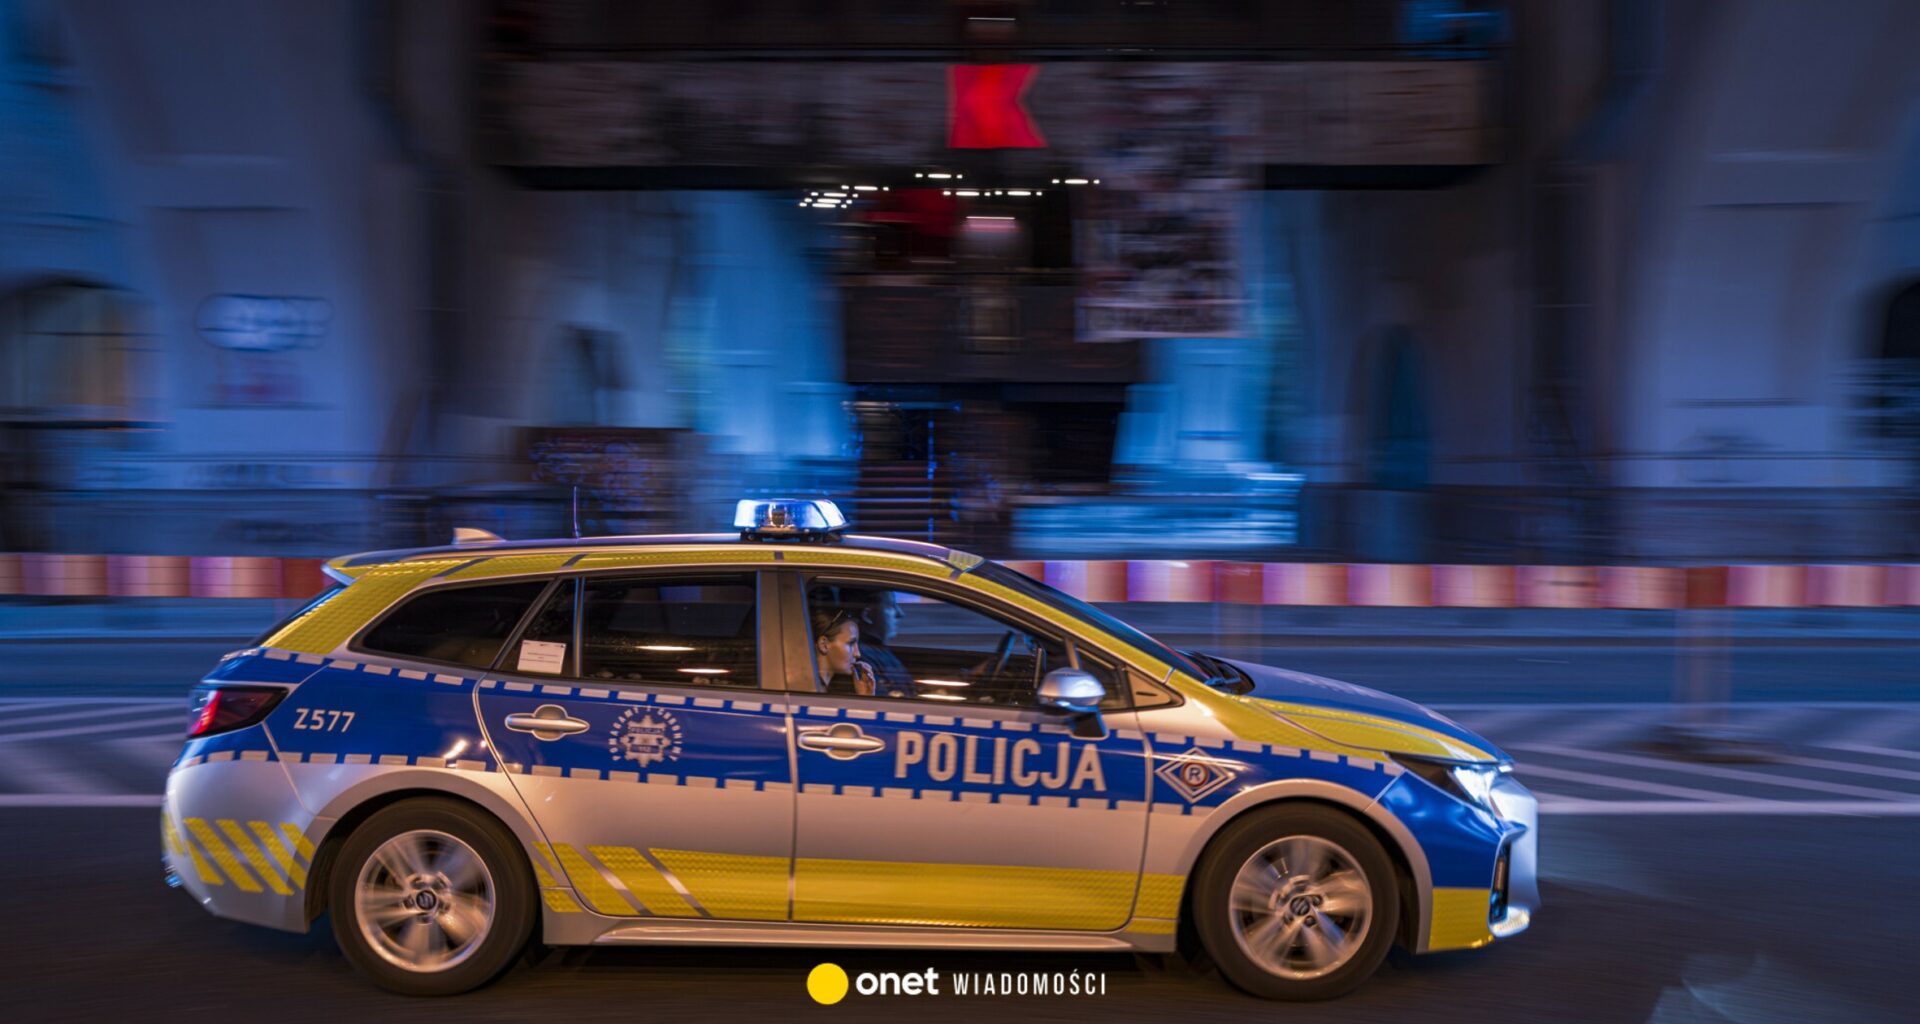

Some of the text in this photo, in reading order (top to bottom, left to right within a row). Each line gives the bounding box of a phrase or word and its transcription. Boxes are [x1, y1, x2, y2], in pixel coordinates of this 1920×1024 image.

[293, 708, 356, 733] Z577
[894, 731, 1107, 791] POLICJA
[1189, 767, 1201, 781] R
